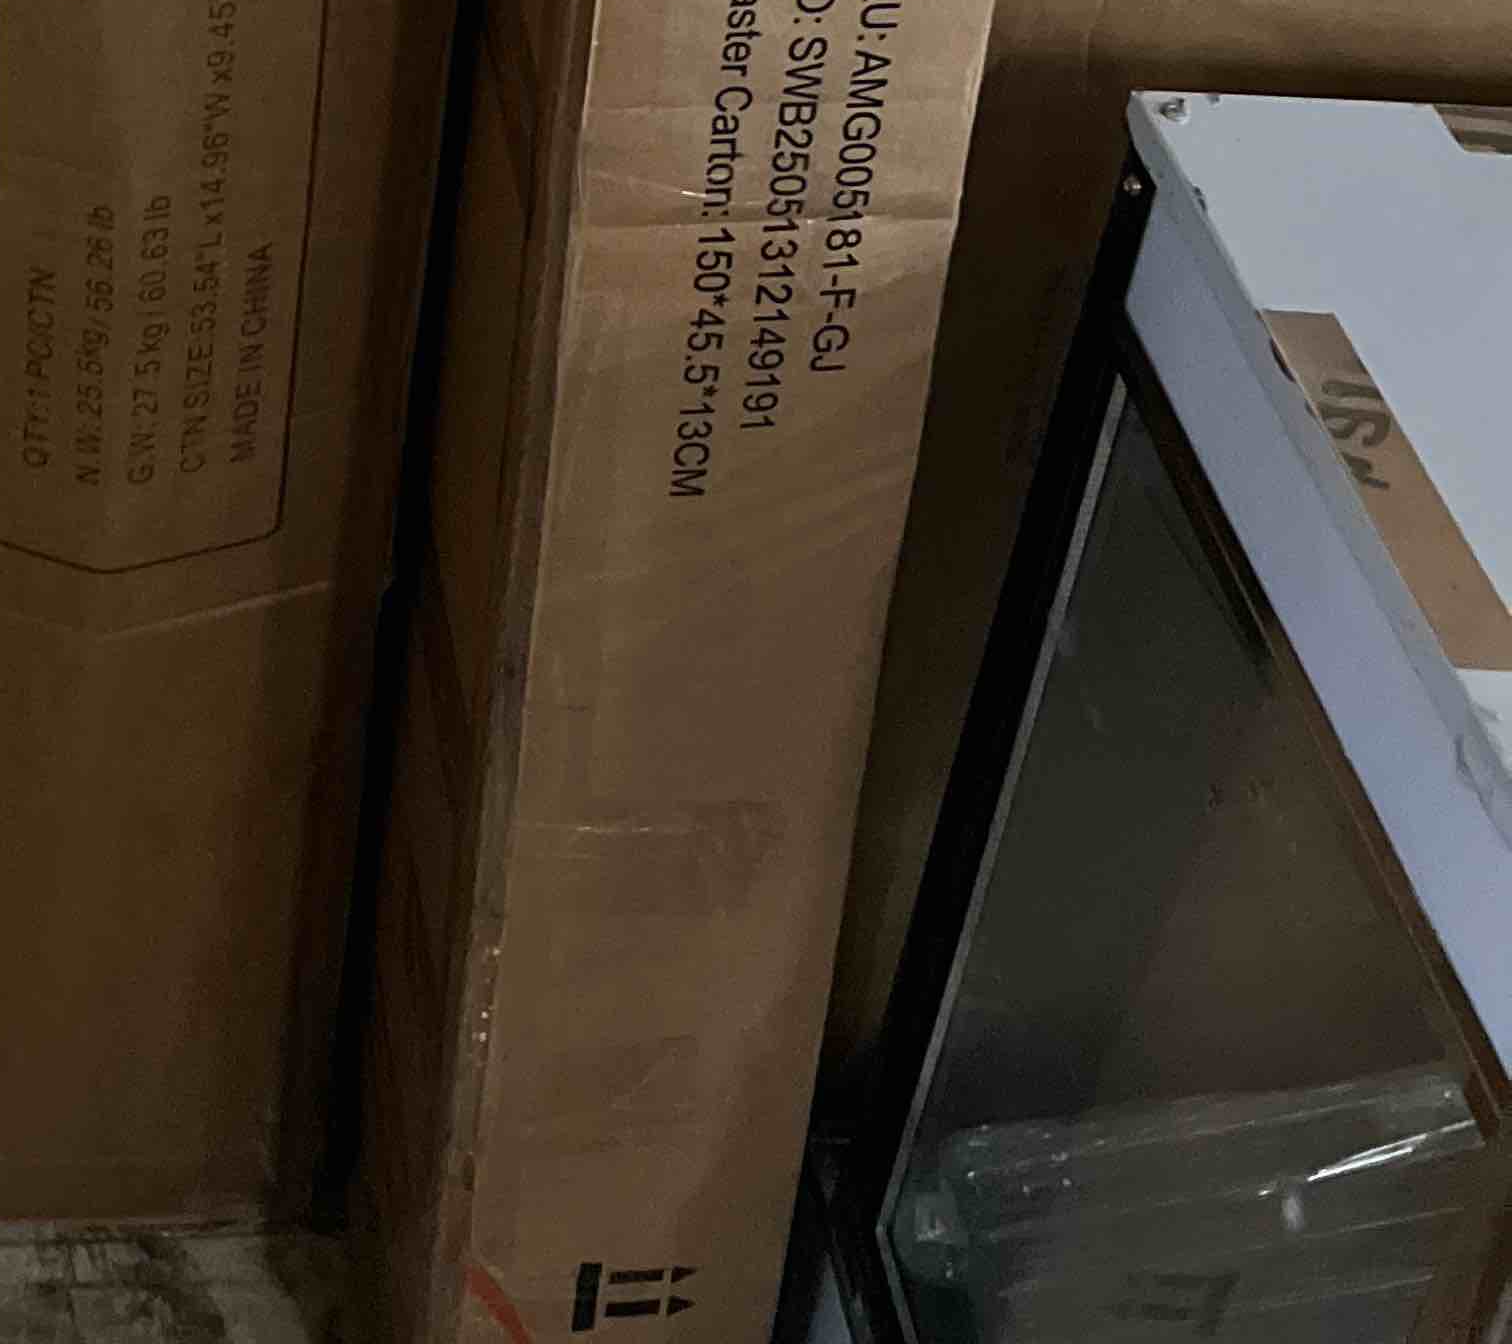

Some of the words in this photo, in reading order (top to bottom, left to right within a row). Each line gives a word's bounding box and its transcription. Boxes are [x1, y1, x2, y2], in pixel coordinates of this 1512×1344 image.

[700, 87, 753, 218] Carton:
[740, 35, 829, 429] SWB25051312149191
[809, 47, 891, 374] AMG005181-F-GJ
[241, 241, 273, 337] CHINA
[239, 343, 265, 373] IN
[230, 380, 262, 463] MADE
